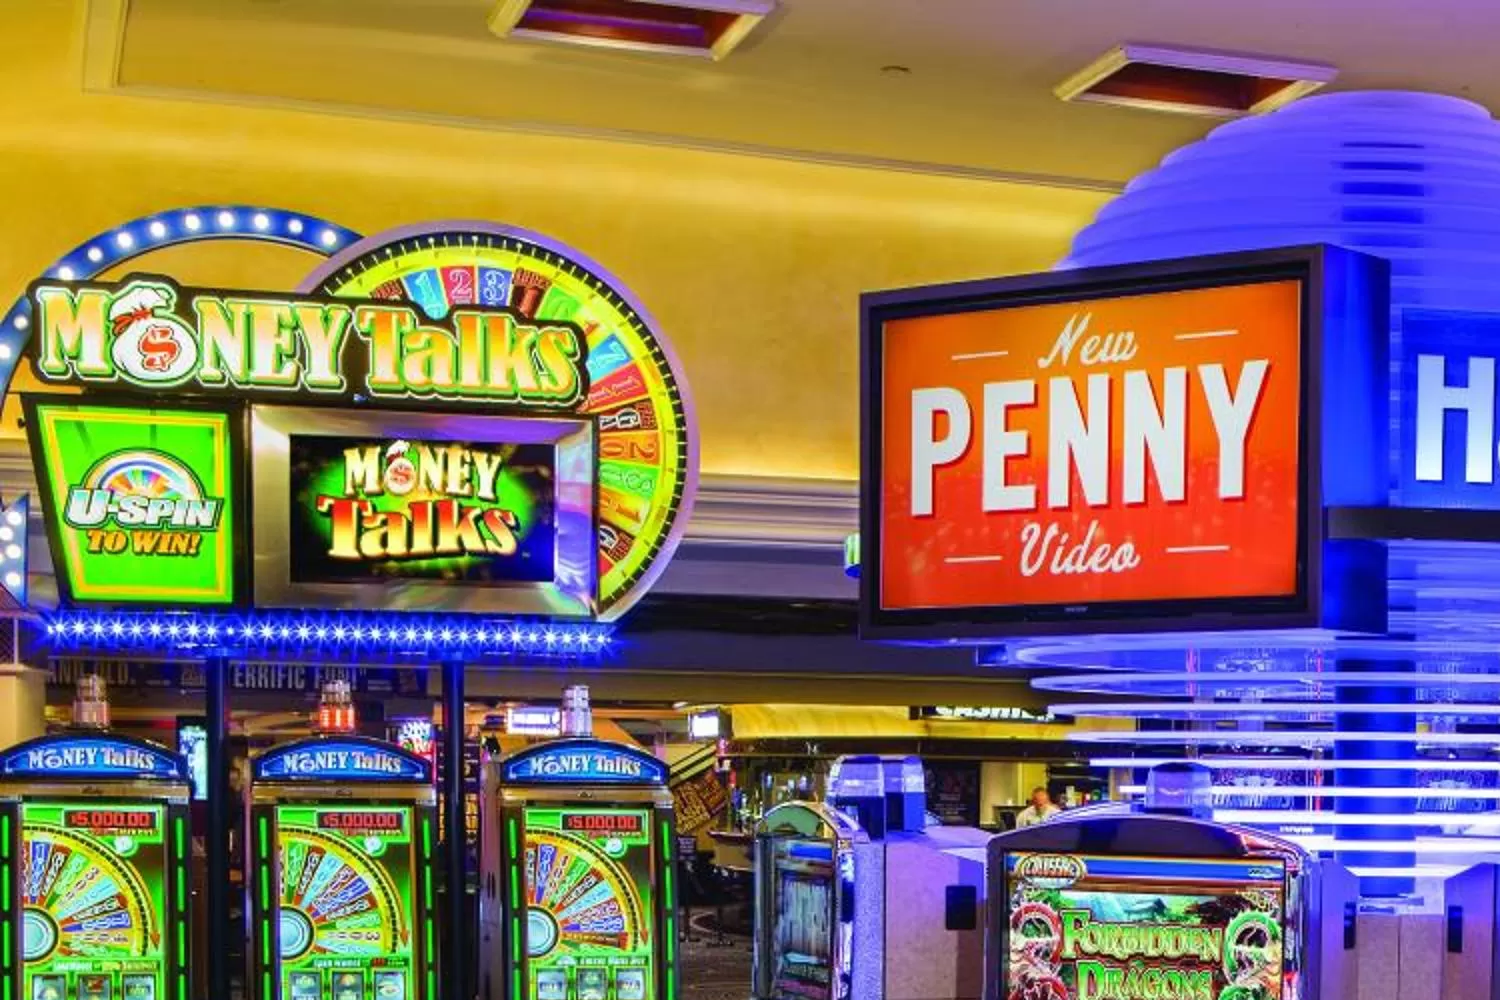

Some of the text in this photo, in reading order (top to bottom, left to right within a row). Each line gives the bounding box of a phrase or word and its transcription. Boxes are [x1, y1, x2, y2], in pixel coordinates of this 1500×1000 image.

[38, 284, 582, 403] MONEY Talks
[1039, 313, 1138, 370] New
[910, 357, 1273, 517] PENNY
[343, 440, 502, 498] MONEY
[66, 487, 219, 530] U-SPIN
[318, 494, 522, 559] Talks
[87, 530, 201, 556] TO WIN!
[1021, 521, 1140, 579] Video
[232, 663, 305, 689] ERRIFIC
[28, 747, 97, 769] MONEY
[283, 751, 351, 772] MONEY
[530, 755, 593, 775] MONEY
